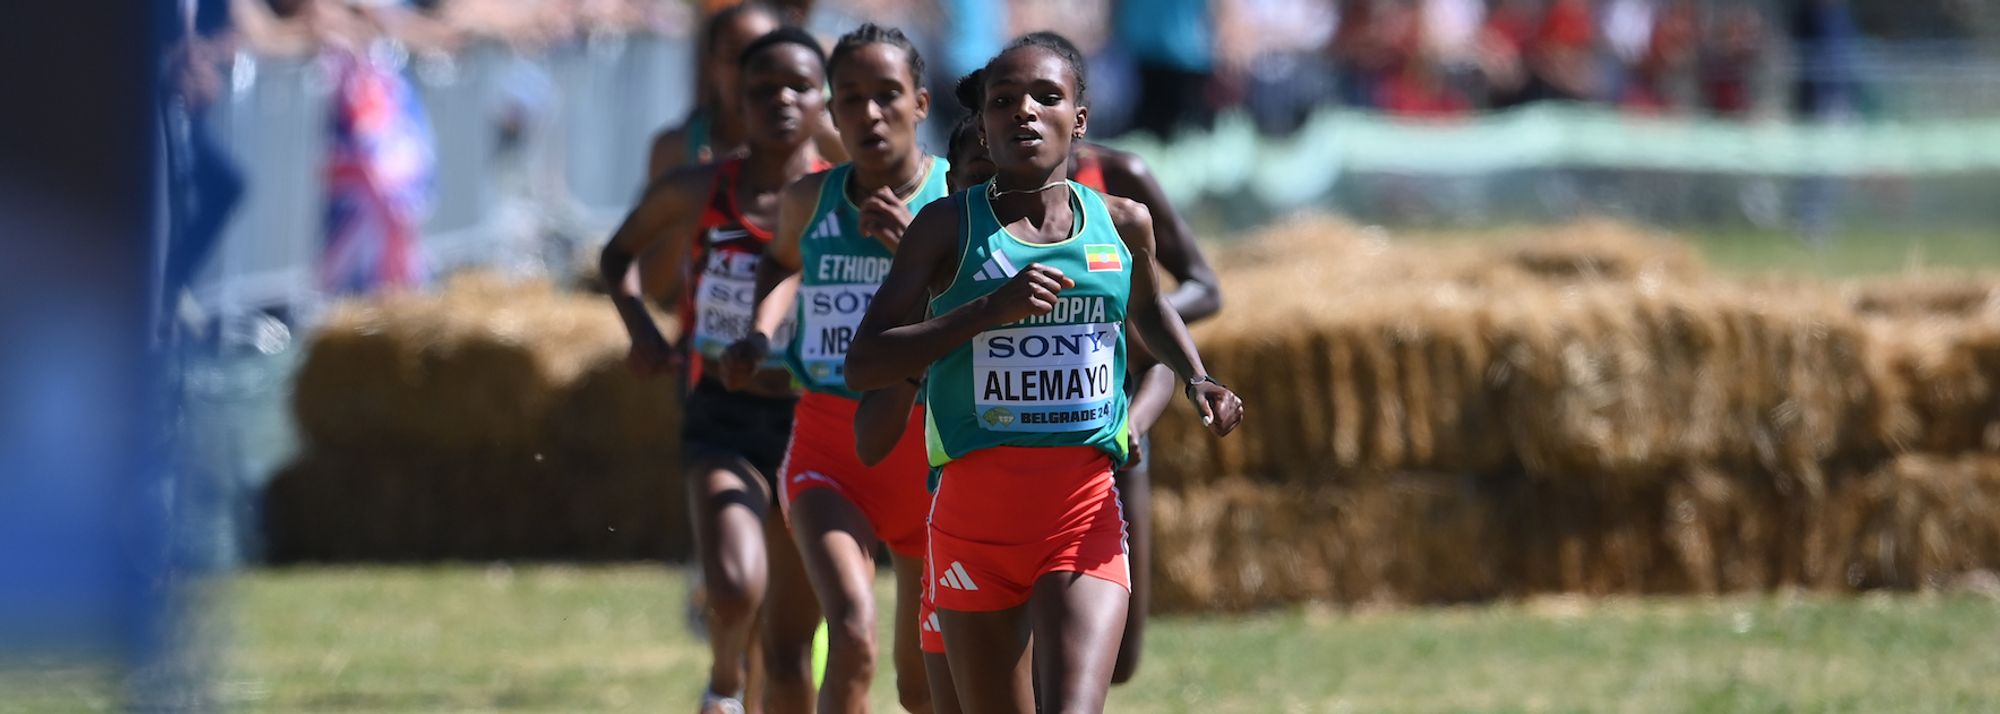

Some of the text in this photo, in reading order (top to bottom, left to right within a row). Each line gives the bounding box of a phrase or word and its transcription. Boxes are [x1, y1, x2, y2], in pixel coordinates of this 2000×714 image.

[818, 254, 895, 282] ETHIOP
[1001, 297, 1106, 326] OPIA
[988, 331, 1107, 358] SONY
[984, 363, 1108, 401] ALEMAYO
[1020, 408, 1097, 424] BELGRADE
